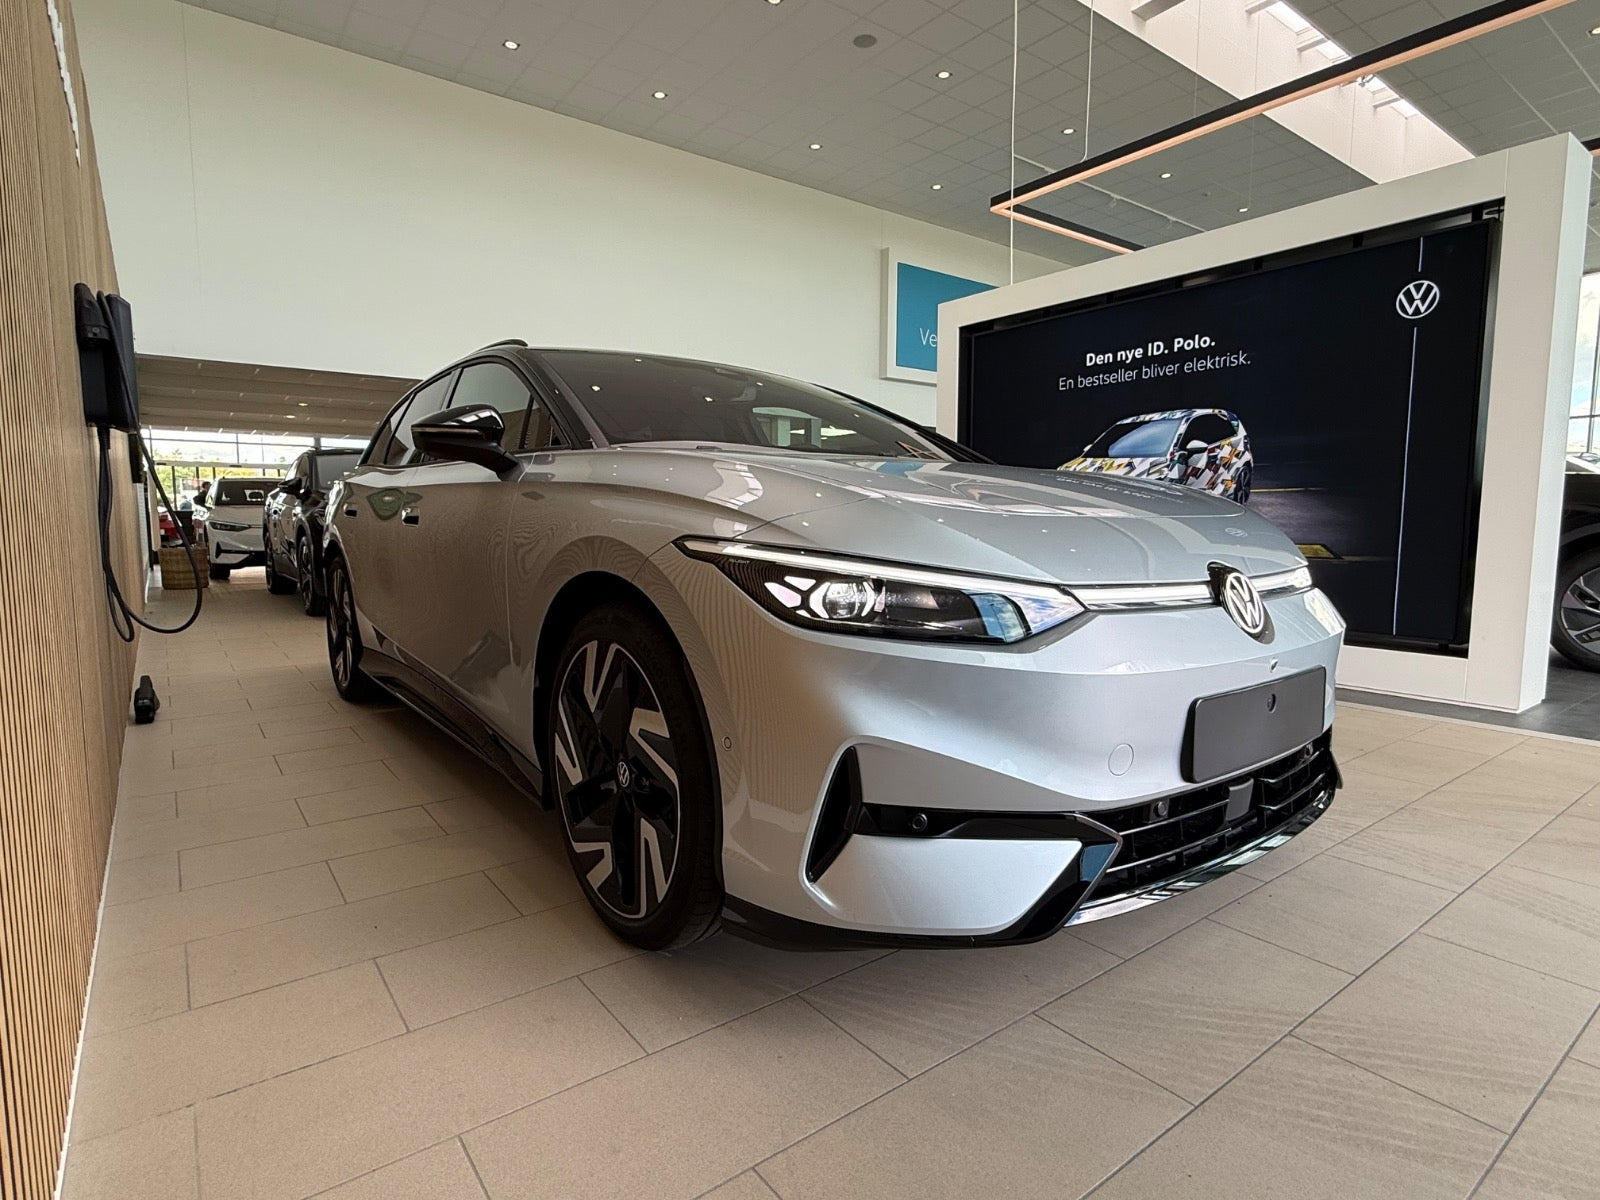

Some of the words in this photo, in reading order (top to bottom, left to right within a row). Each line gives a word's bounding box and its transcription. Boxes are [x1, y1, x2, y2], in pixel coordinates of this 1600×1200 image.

[1086, 352, 1113, 367] Den
[1117, 347, 1144, 364] nye
[1147, 341, 1169, 357] ID.
[1173, 334, 1216, 353] Polo.
[1058, 377, 1074, 391] En
[1077, 368, 1139, 388] bestseller
[1141, 362, 1180, 379] bliver
[1183, 350, 1251, 373] elektrisk.
